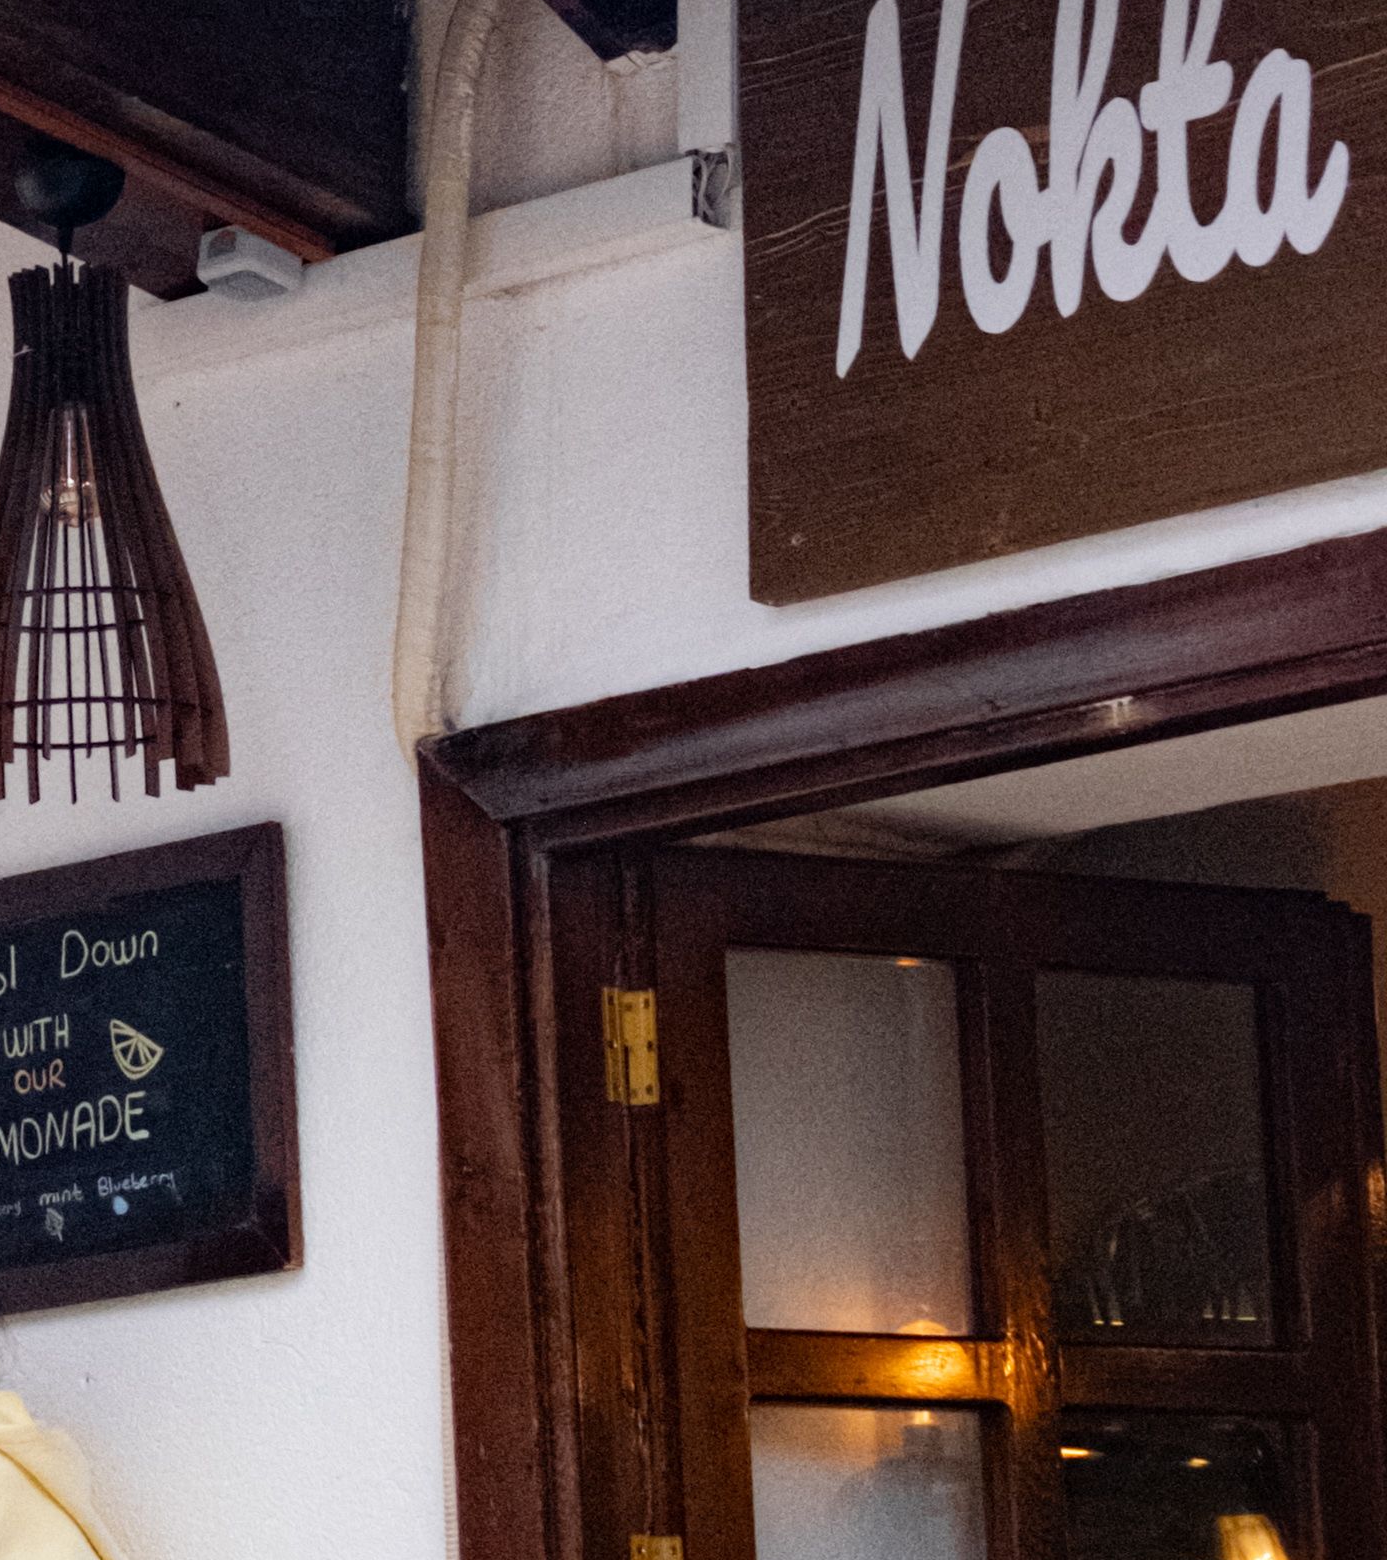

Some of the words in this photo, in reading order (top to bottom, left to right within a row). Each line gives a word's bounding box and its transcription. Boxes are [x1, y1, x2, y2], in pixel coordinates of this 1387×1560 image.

[60, 929, 160, 981] Down
[3, 1013, 70, 1059] WITH
[13, 1058, 66, 1096] OUR
[38, 1183, 85, 1208] mint
[96, 1171, 178, 1198] Blueberry
